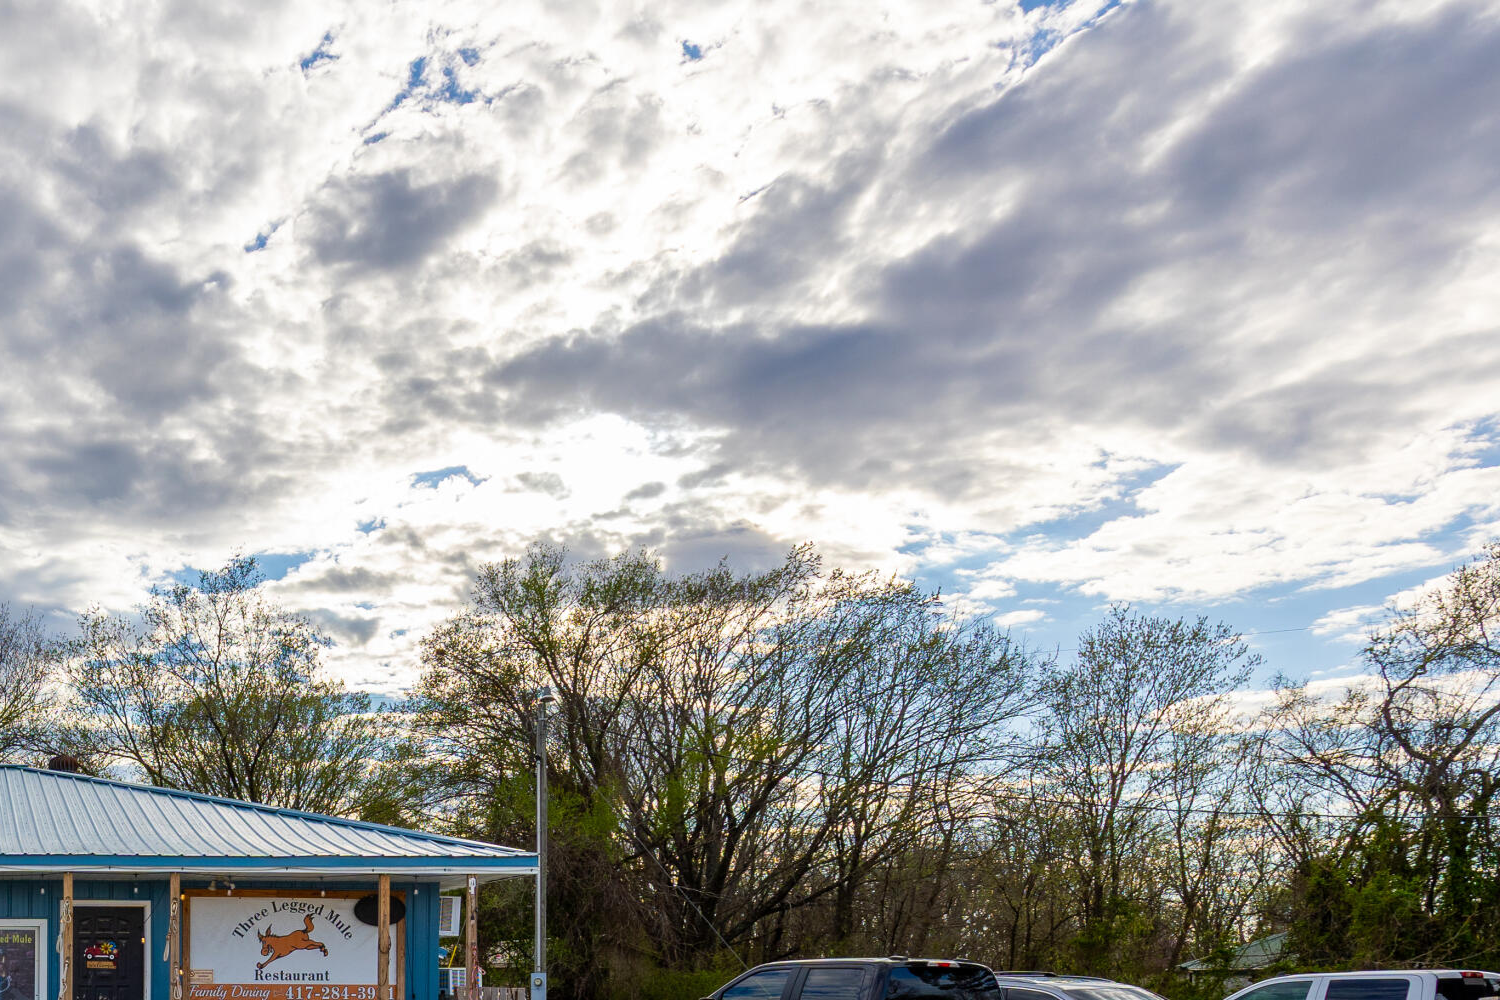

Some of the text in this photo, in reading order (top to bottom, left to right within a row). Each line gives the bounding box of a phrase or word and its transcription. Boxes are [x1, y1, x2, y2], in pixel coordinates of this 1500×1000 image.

[232, 901, 353, 941] Three Legged Mule
[12, 934, 33, 944] Mule
[254, 969, 331, 982] Restaurant
[189, 984, 271, 1000] Family Dining
[285, 986, 395, 1000] 417-284-391
